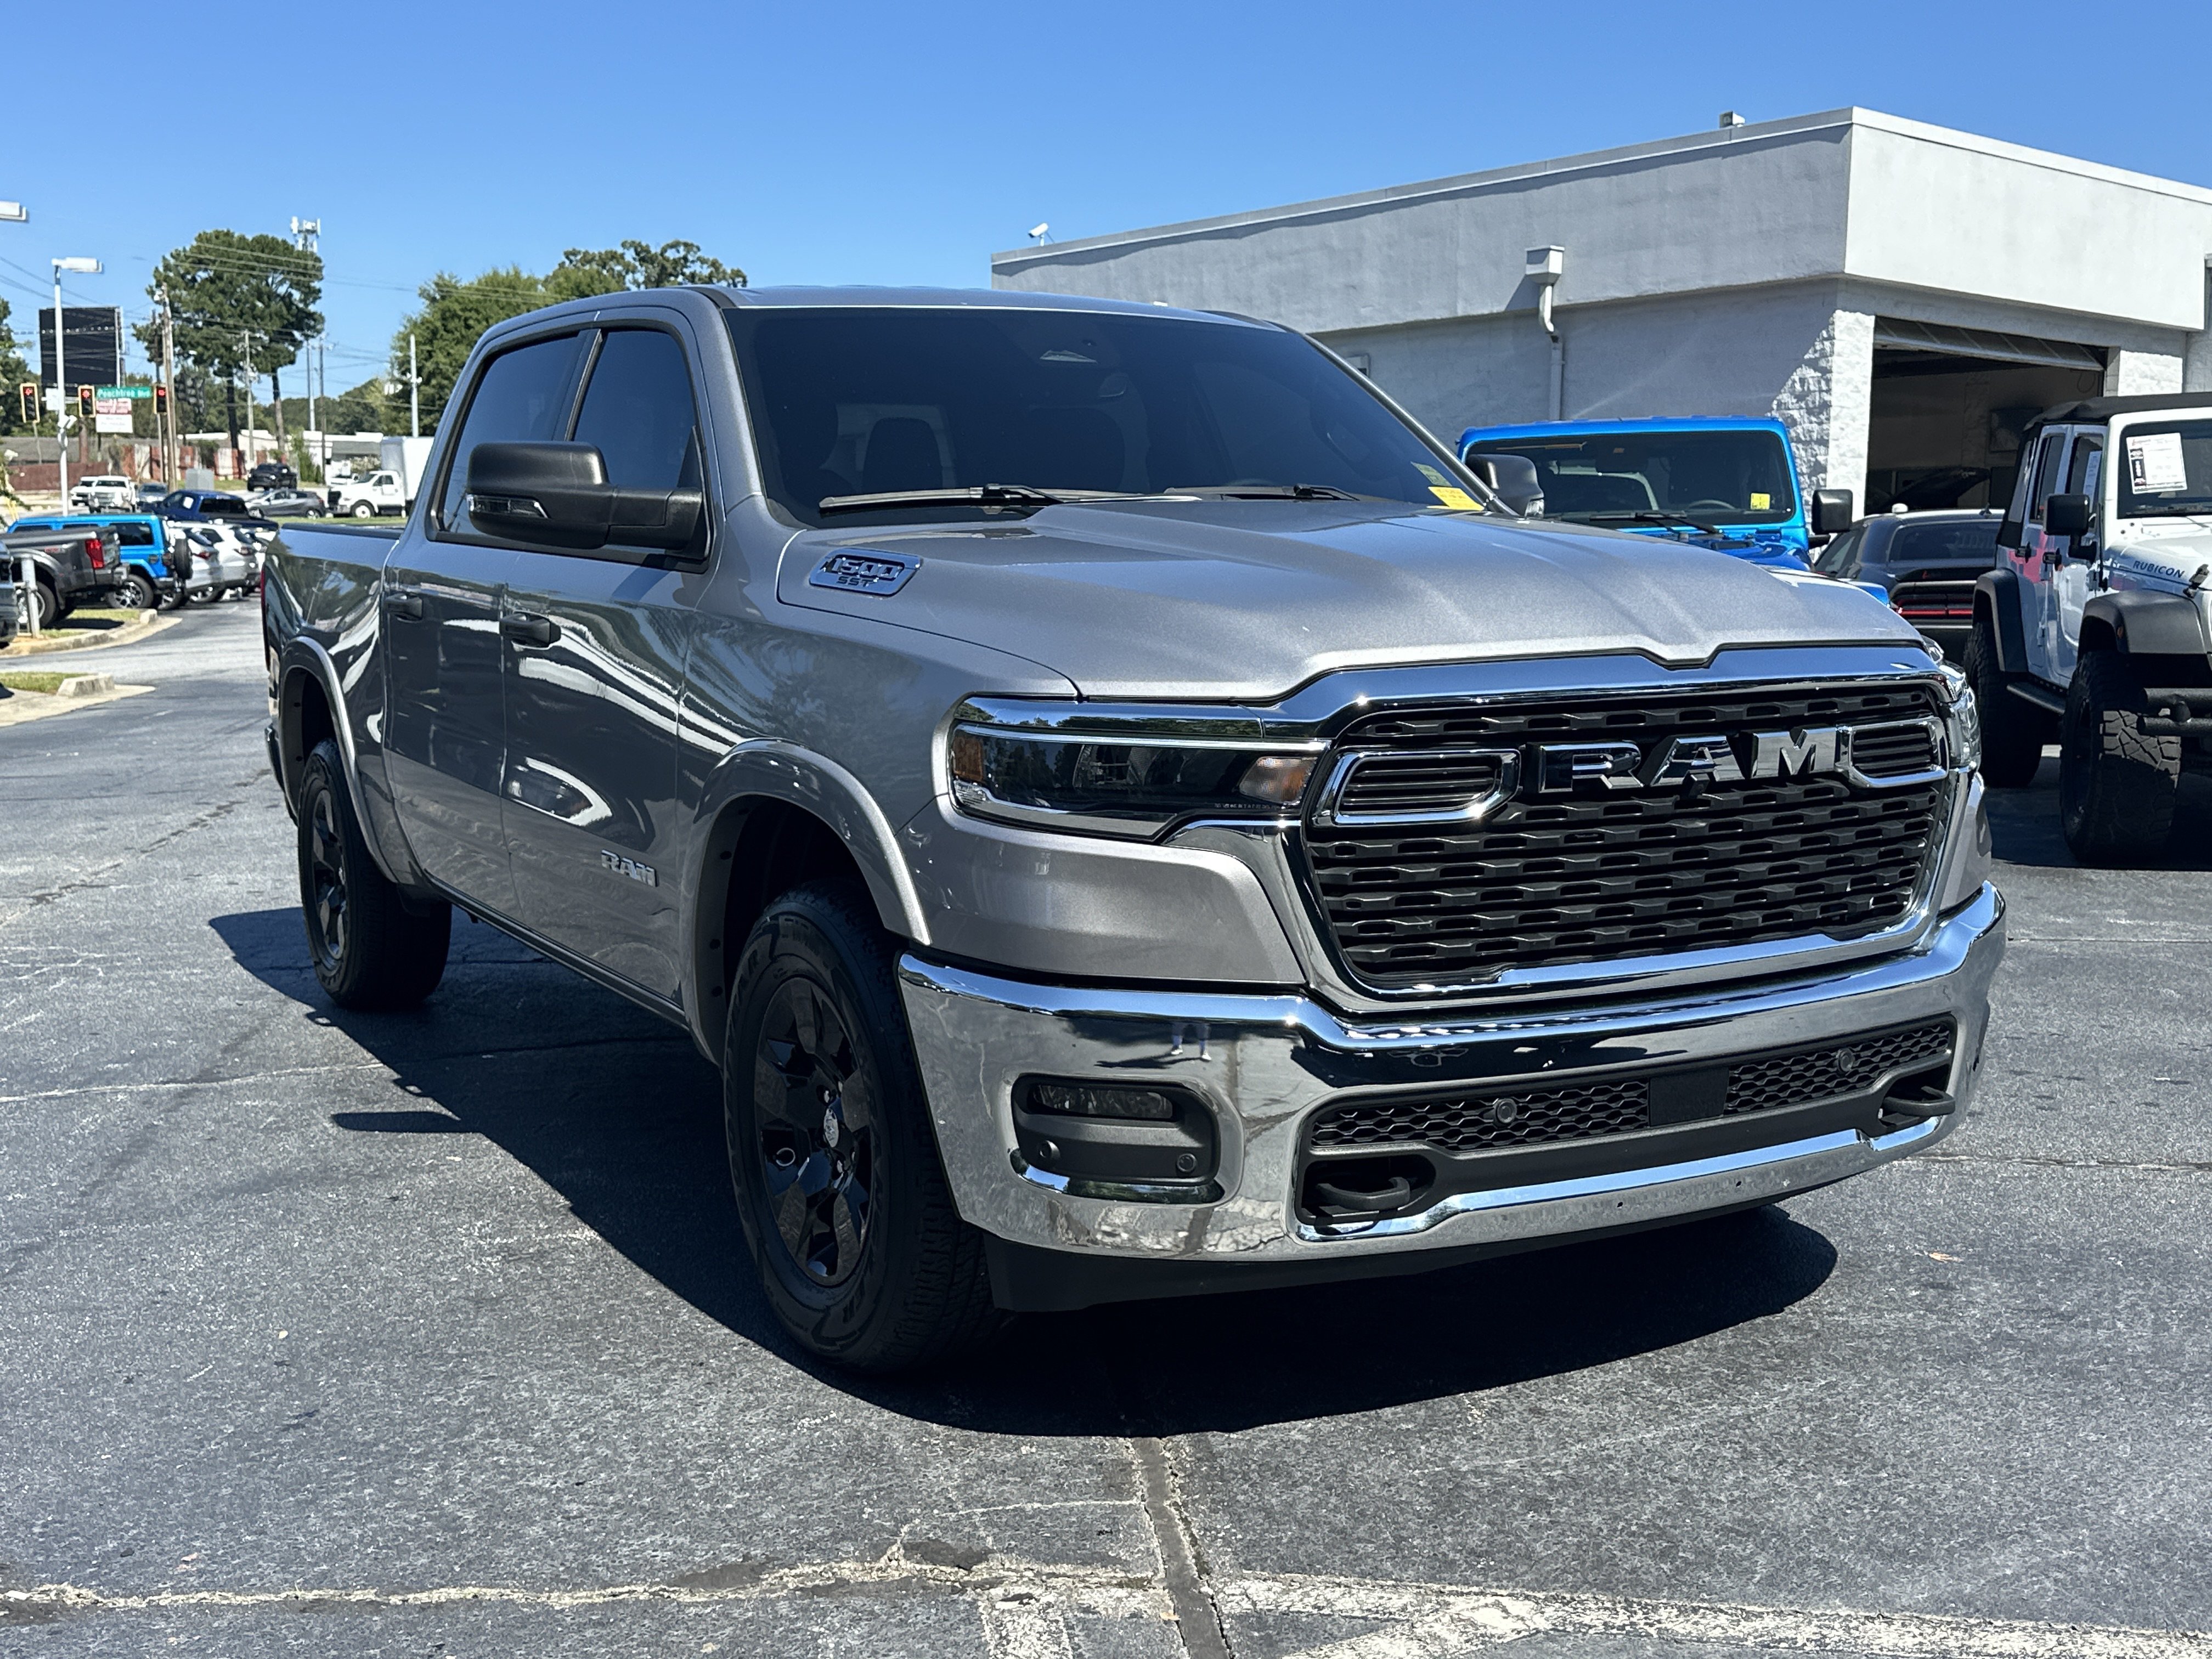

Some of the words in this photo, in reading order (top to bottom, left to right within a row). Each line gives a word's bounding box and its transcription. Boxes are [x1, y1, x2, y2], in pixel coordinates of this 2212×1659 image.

[831, 556, 901, 579] 1500
[2133, 561, 2185, 578] RUBICON
[837, 576, 876, 587] SST
[1538, 727, 1837, 793] RAM
[601, 849, 658, 887] RAM
